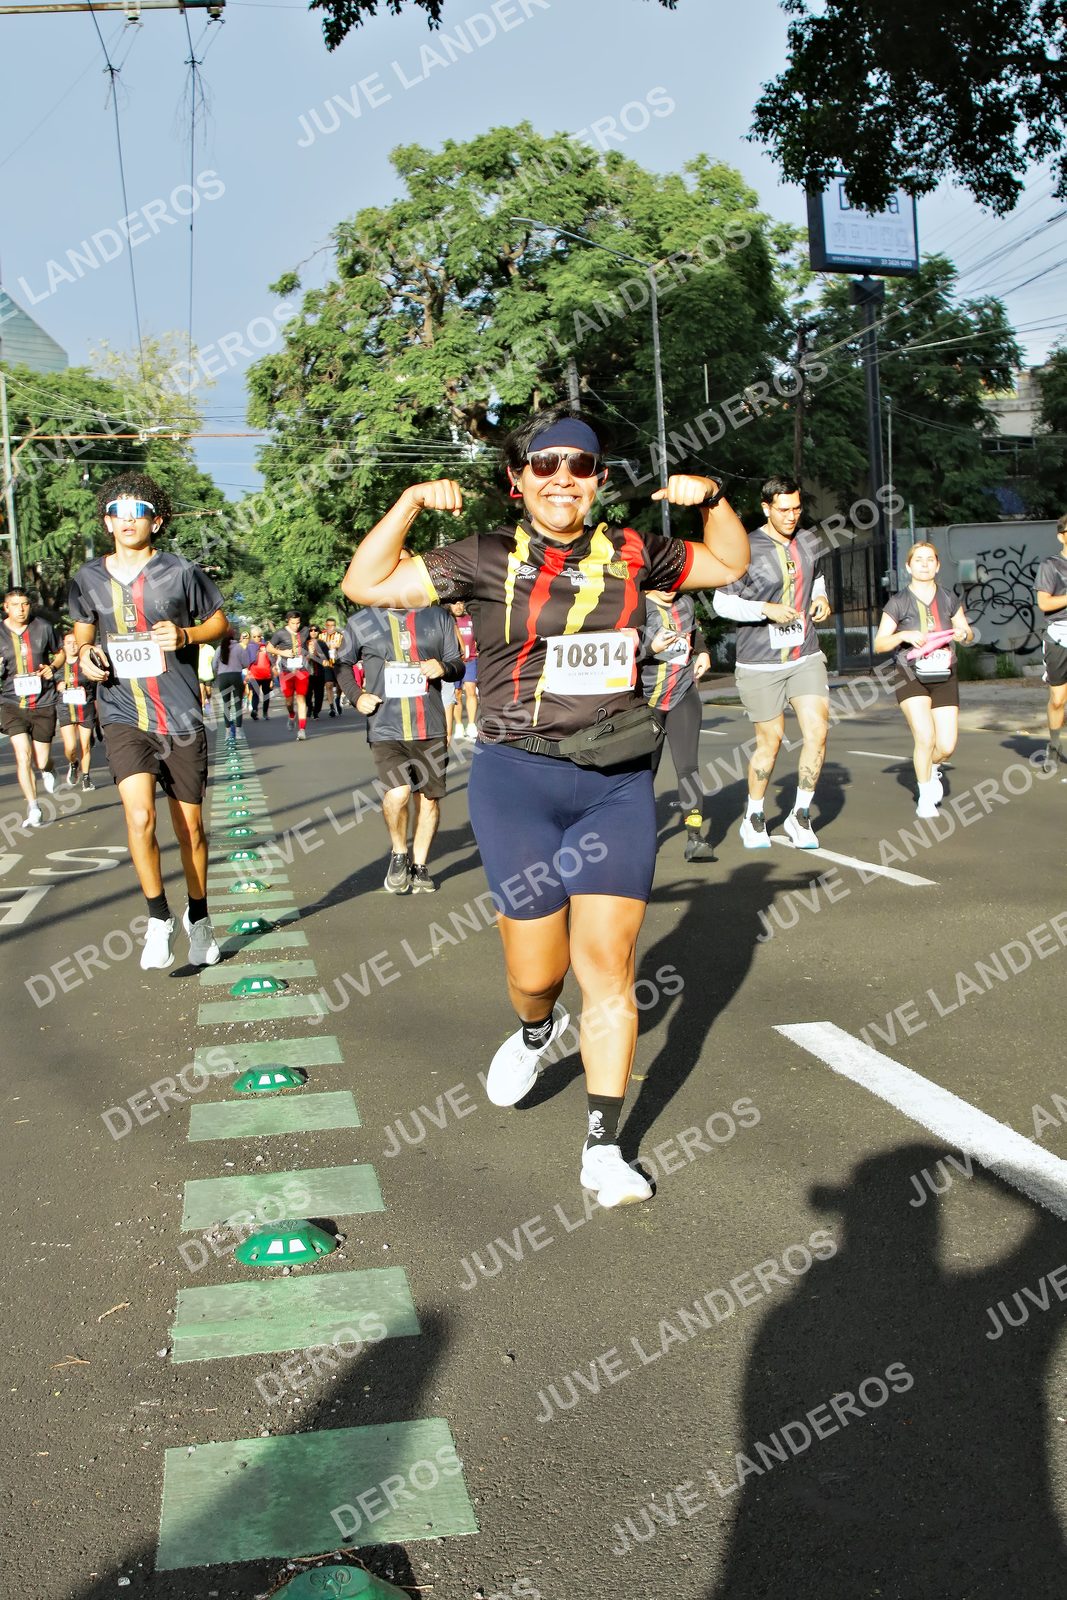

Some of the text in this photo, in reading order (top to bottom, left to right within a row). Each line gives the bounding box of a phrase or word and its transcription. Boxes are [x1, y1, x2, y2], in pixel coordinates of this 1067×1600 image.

[977, 544, 1027, 564] TOY
[115, 647, 151, 662] 8603
[553, 641, 628, 668] 10814
